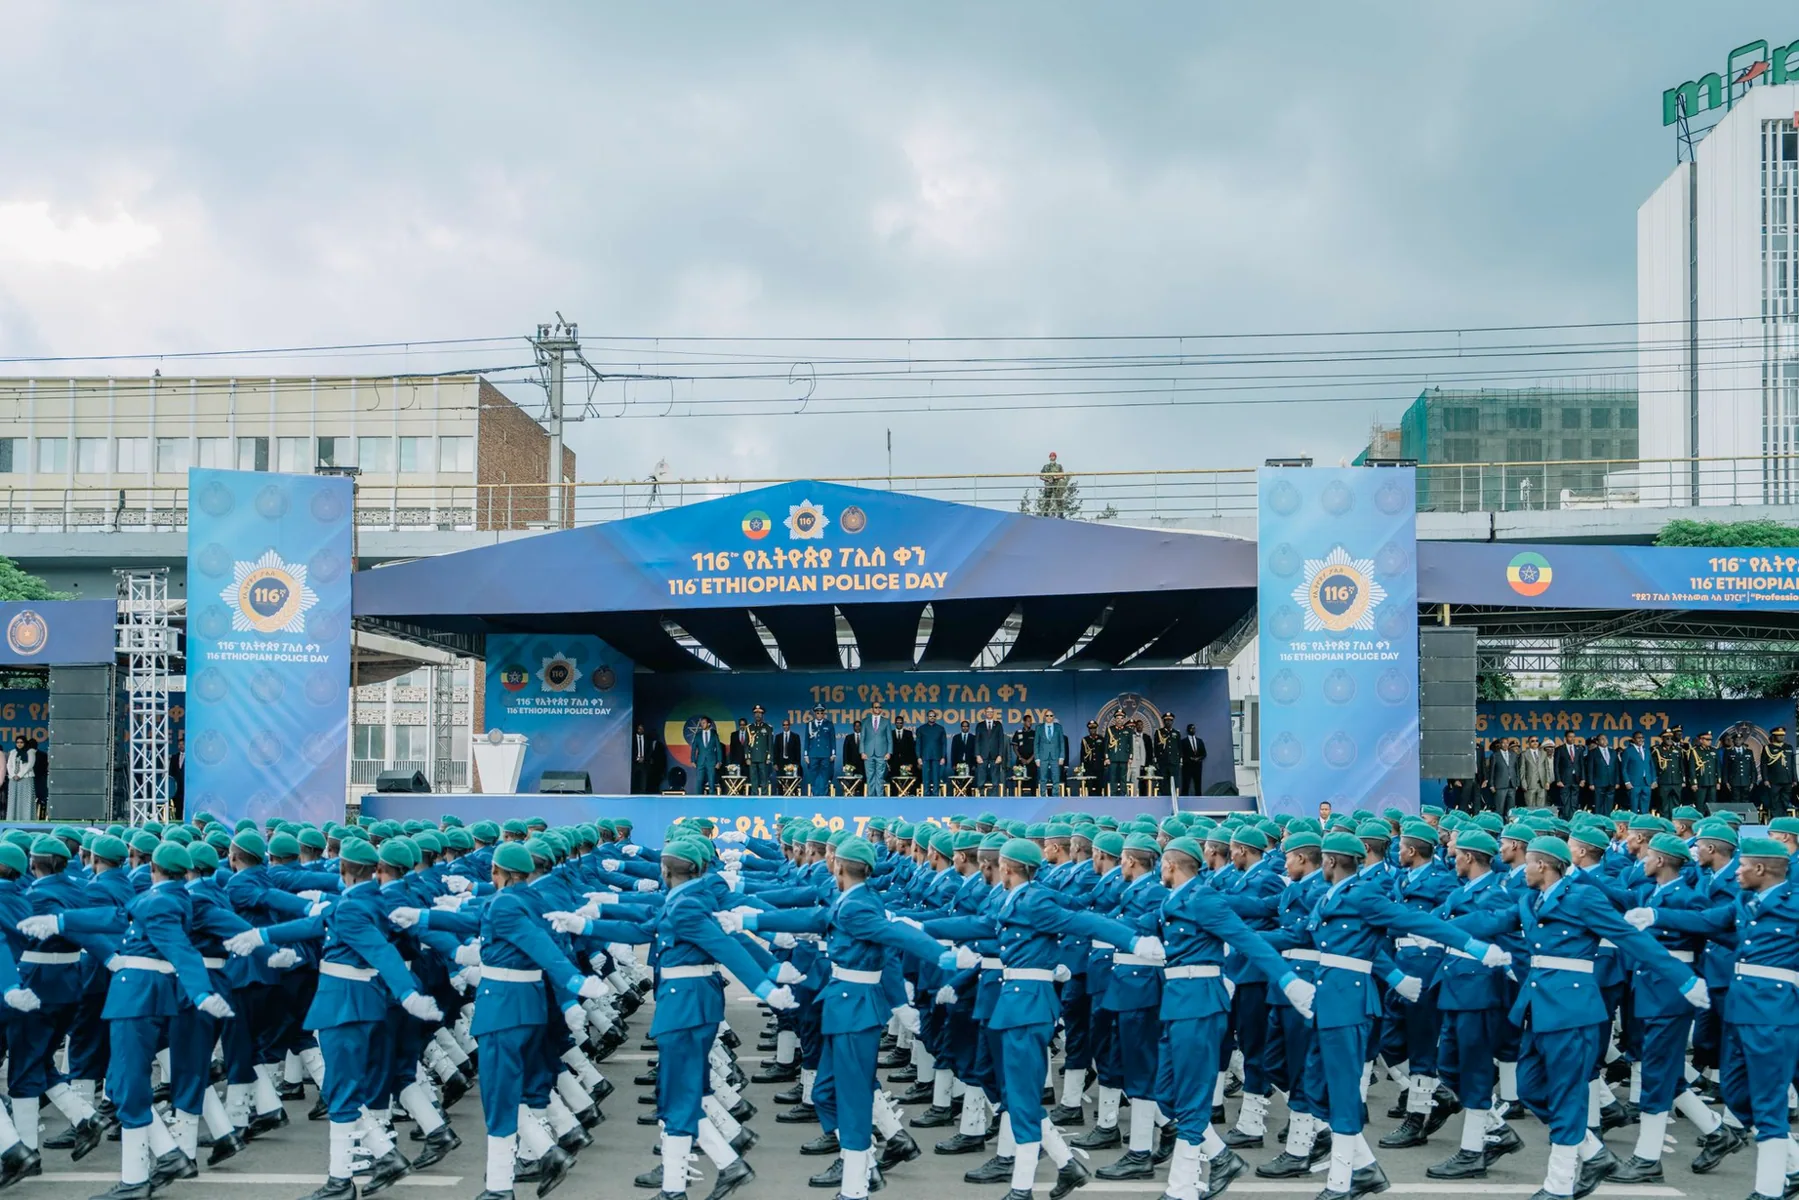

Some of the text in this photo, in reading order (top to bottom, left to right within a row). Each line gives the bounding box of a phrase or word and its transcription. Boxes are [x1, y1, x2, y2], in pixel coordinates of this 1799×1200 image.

[743, 546, 833, 570] የኢትዮጵያ
[839, 546, 886, 568] ፖሊስ
[893, 546, 926, 567] ቀን
[1749, 555, 1799, 573] የኢትዮ
[701, 575, 818, 595] ETHIOPIAN
[822, 572, 900, 592] POLICE
[905, 571, 949, 590] DAY
[1717, 576, 1799, 591] ETHIOPIA
[221, 652, 272, 662] ETHIOPIAN
[274, 653, 309, 663] POLICE
[310, 654, 330, 664] DAY
[1294, 652, 1344, 662] ETHIOPIAN
[1346, 652, 1380, 661] POLICE
[1380, 651, 1400, 661] DAY
[857, 681, 941, 703] የኢትዮጵያ
[947, 683, 991, 703] ፖሊስ
[997, 684, 1028, 703] ቀን
[519, 707, 563, 715] ETHIOPIAN
[564, 707, 594, 715] POLICE
[594, 707, 612, 715] DAY
[1500, 710, 1583, 731] የኢትዮጵያ
[1589, 711, 1633, 731] ፖሊስ
[1639, 711, 1670, 731] ቀን
